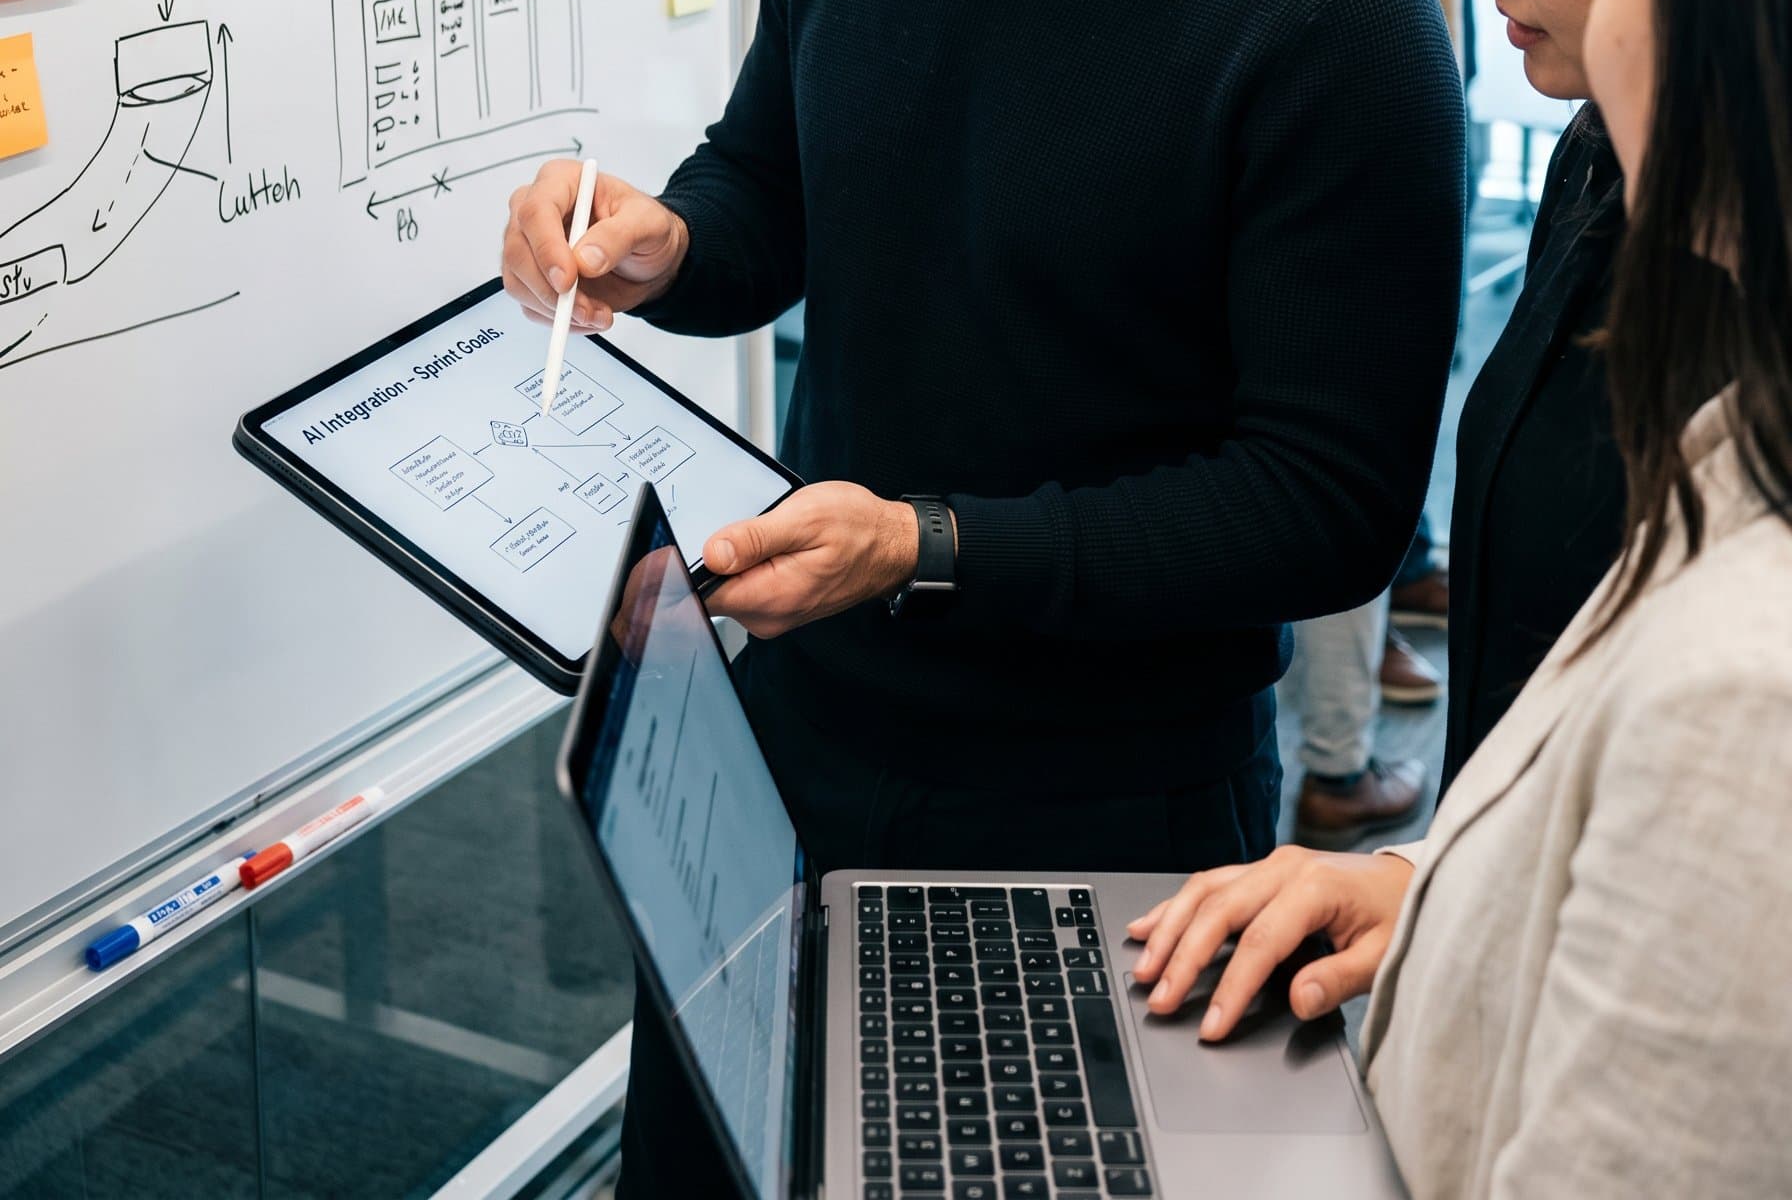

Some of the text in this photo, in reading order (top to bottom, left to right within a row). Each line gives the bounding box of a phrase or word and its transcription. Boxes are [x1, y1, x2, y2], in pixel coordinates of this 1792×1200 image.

[302, 425, 326, 445] AI
[320, 378, 409, 434] Integration
[412, 348, 463, 380] Sprint
[456, 326, 505, 355] Goals.
